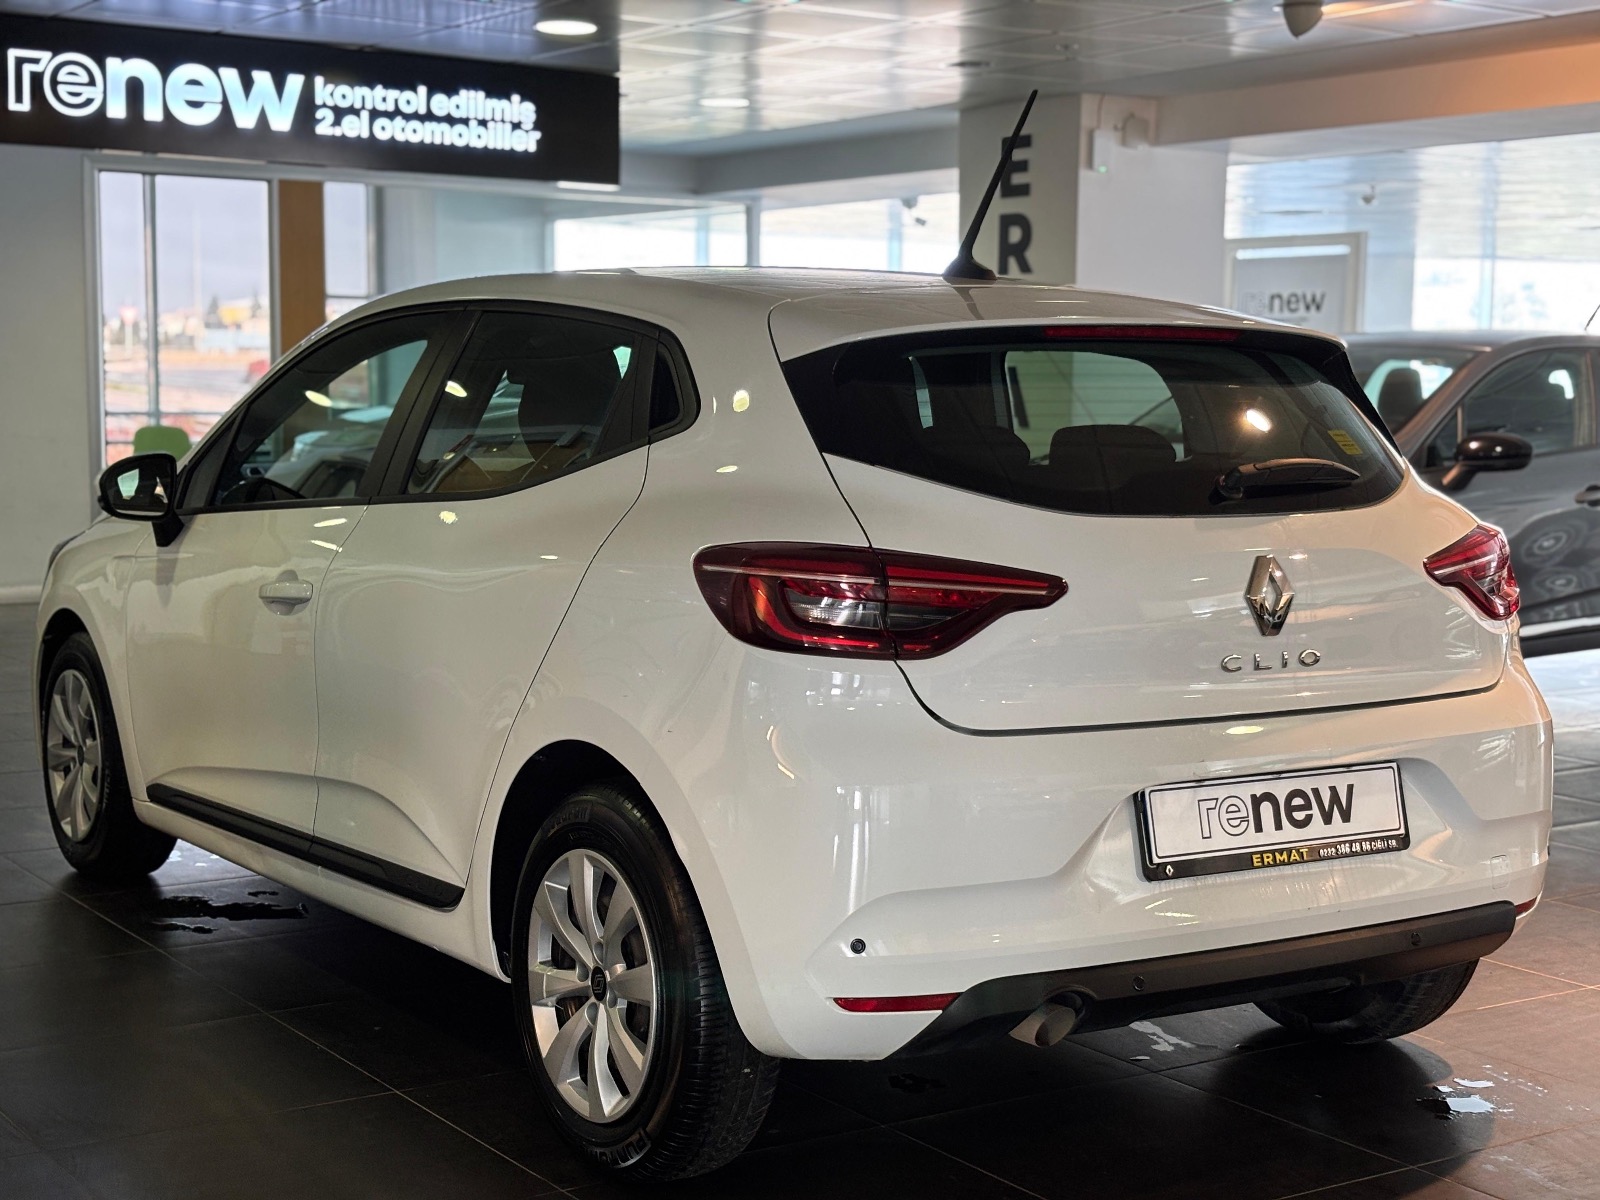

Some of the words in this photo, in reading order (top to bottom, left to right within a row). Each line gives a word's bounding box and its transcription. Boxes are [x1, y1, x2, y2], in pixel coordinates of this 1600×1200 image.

[7, 48, 305, 132] renew
[314, 75, 428, 115] kontrol
[429, 89, 537, 131] edilmiş
[314, 107, 370, 139] 2.el
[372, 115, 542, 153] otomobiller
[1220, 648, 1321, 673] CLIO
[1197, 783, 1354, 840] renew
[1251, 848, 1309, 867] ERMAT
